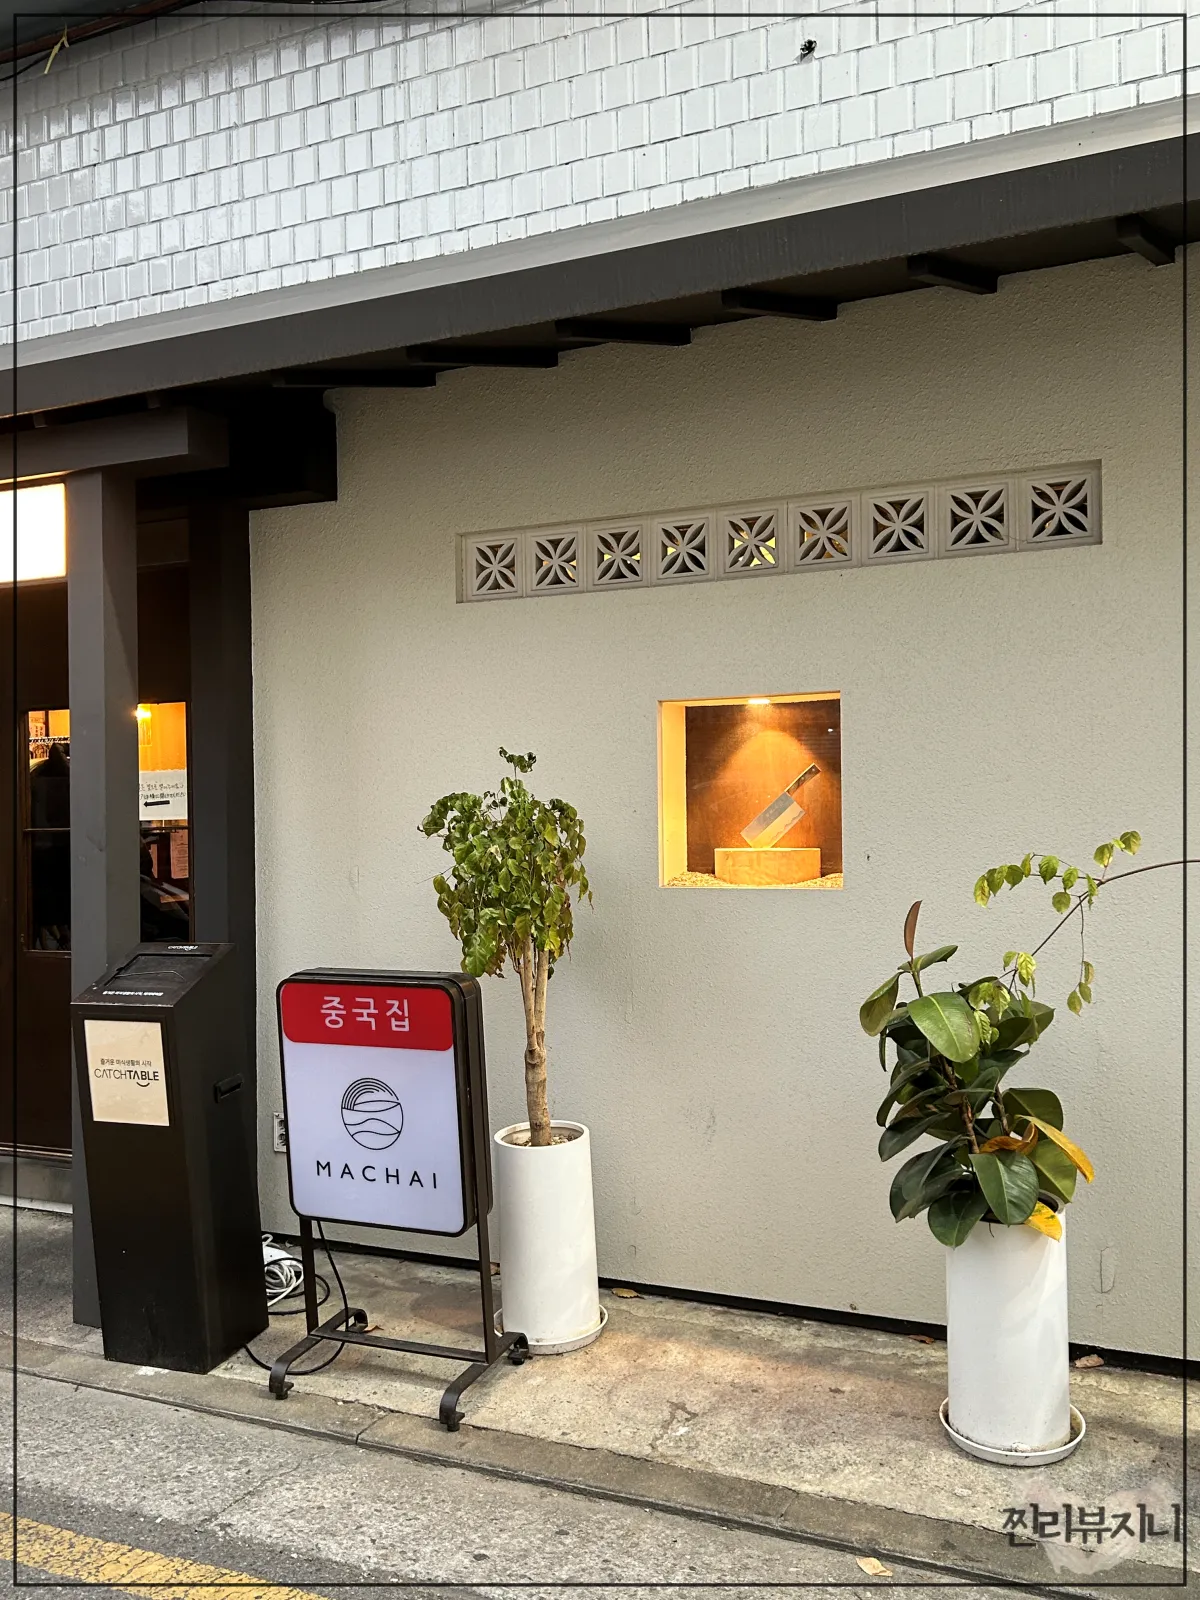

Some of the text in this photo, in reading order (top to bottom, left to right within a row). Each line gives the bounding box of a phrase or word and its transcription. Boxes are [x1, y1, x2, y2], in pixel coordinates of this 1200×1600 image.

[320, 996, 410, 1032] 중국집
[100, 1058, 115, 1066] 즐거운
[93, 1068, 160, 1082] CATCHTABLE
[316, 1159, 437, 1189] MACHAI
